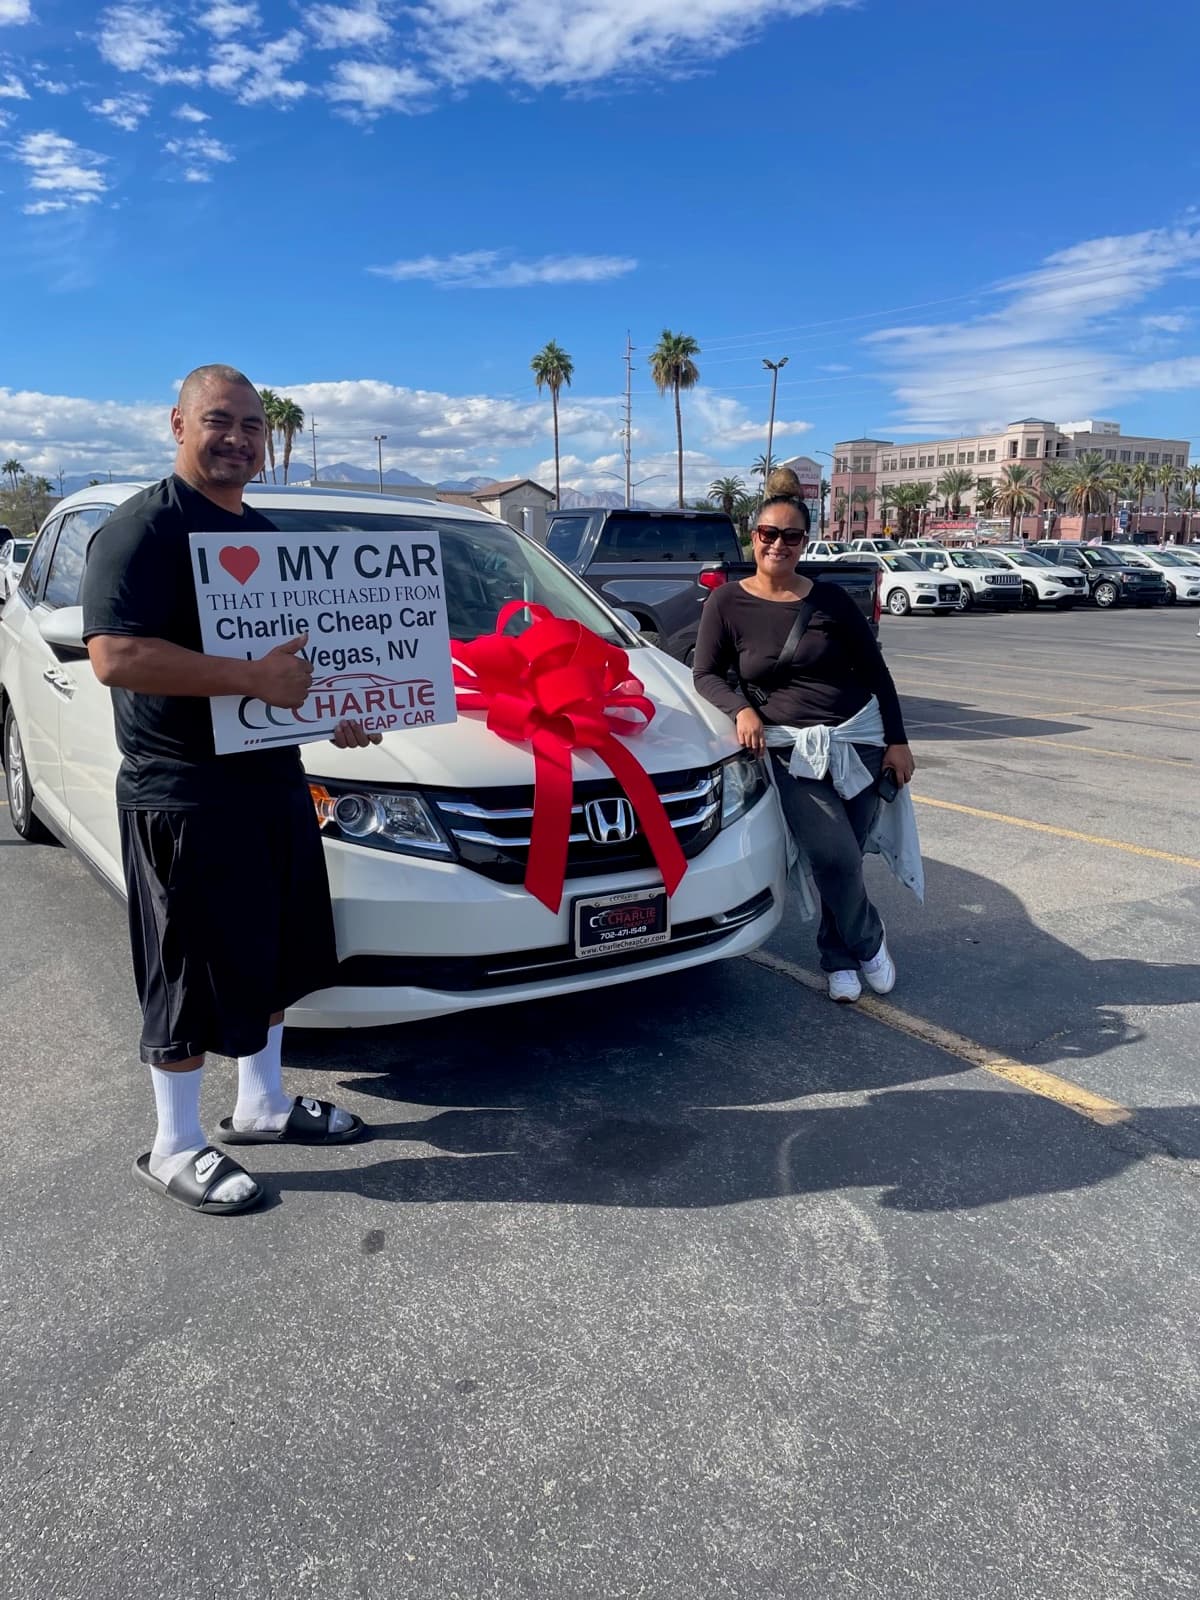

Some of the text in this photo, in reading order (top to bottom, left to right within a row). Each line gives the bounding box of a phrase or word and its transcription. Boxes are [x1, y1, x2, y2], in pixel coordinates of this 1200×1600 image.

[197, 543, 439, 584] I MY CAR
[206, 584, 440, 611] THAT I PURCHASED FROM
[215, 607, 437, 640] Charlie Cheap Car
[302, 638, 419, 671] Vegas, NV
[356, 709, 436, 732] EAP CAR
